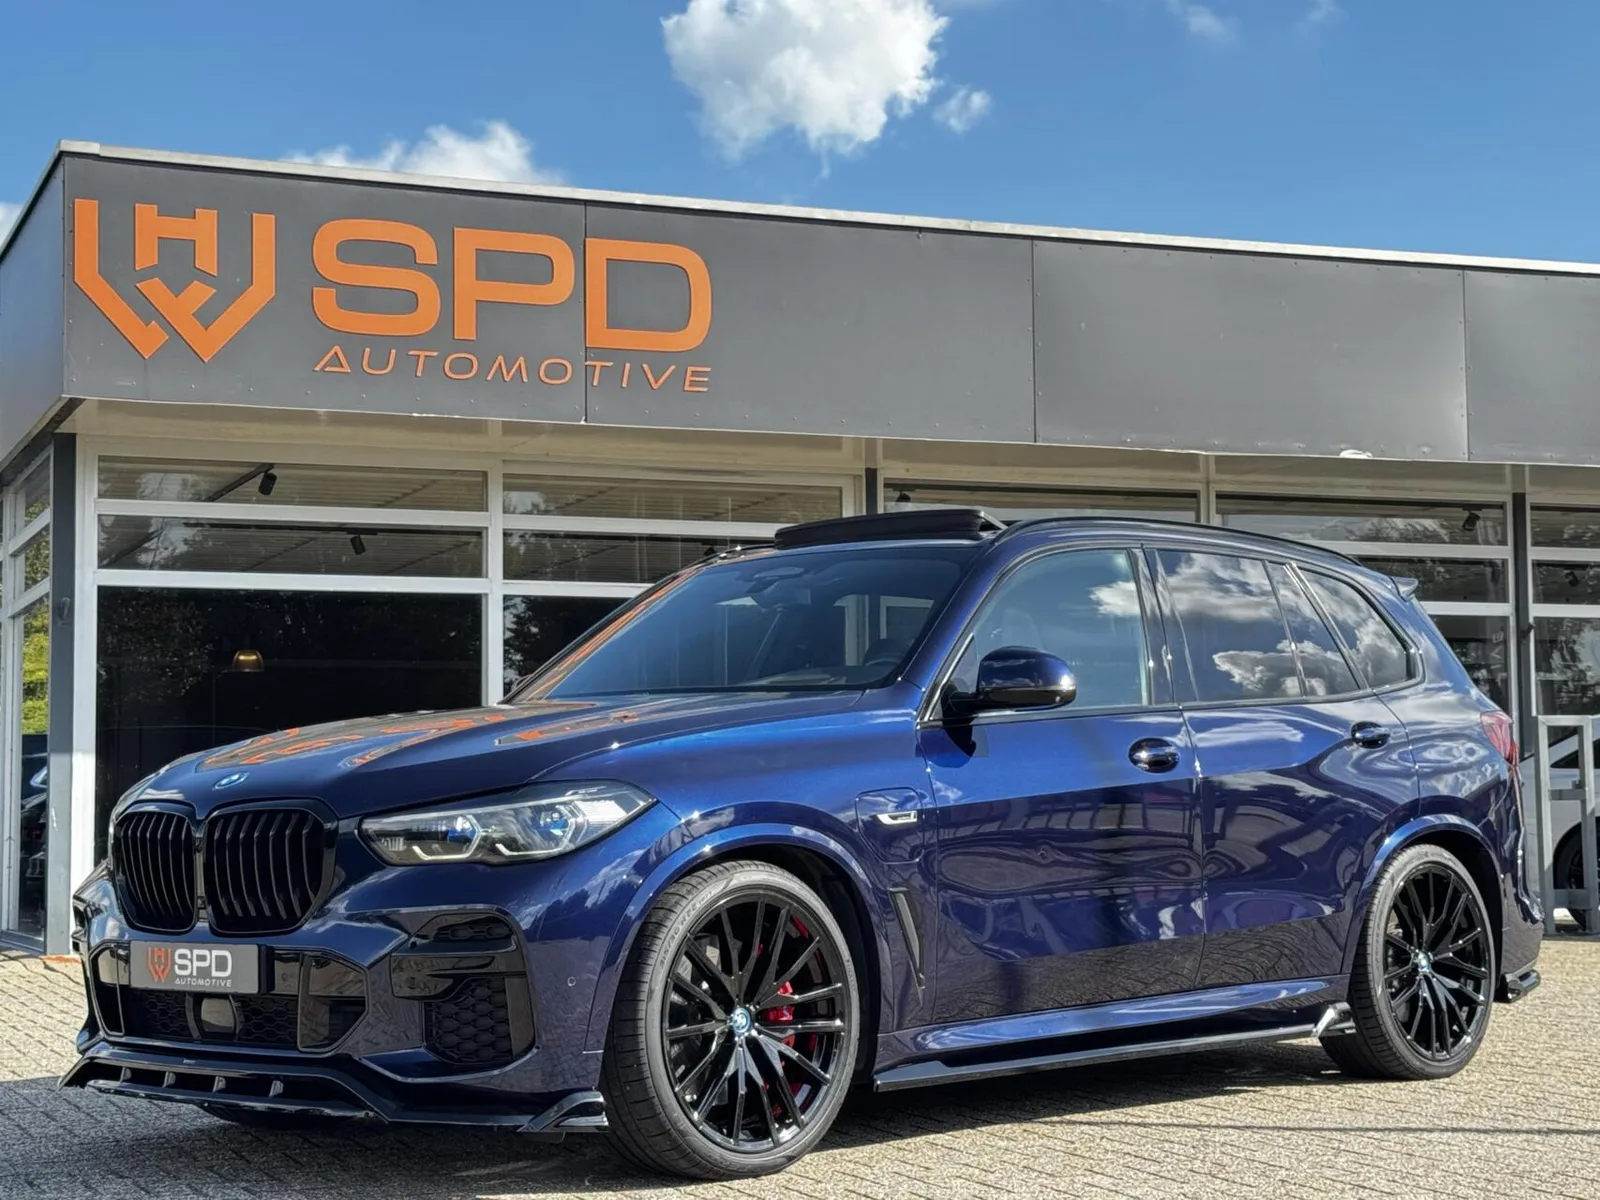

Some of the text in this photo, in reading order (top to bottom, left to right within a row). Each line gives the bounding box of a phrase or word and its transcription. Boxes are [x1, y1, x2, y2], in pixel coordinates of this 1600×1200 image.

[311, 217, 713, 353] SPD
[315, 345, 712, 392] AUTOMOTIVE
[174, 948, 232, 977] SPD
[174, 978, 232, 988] AUTOMOTIVE
